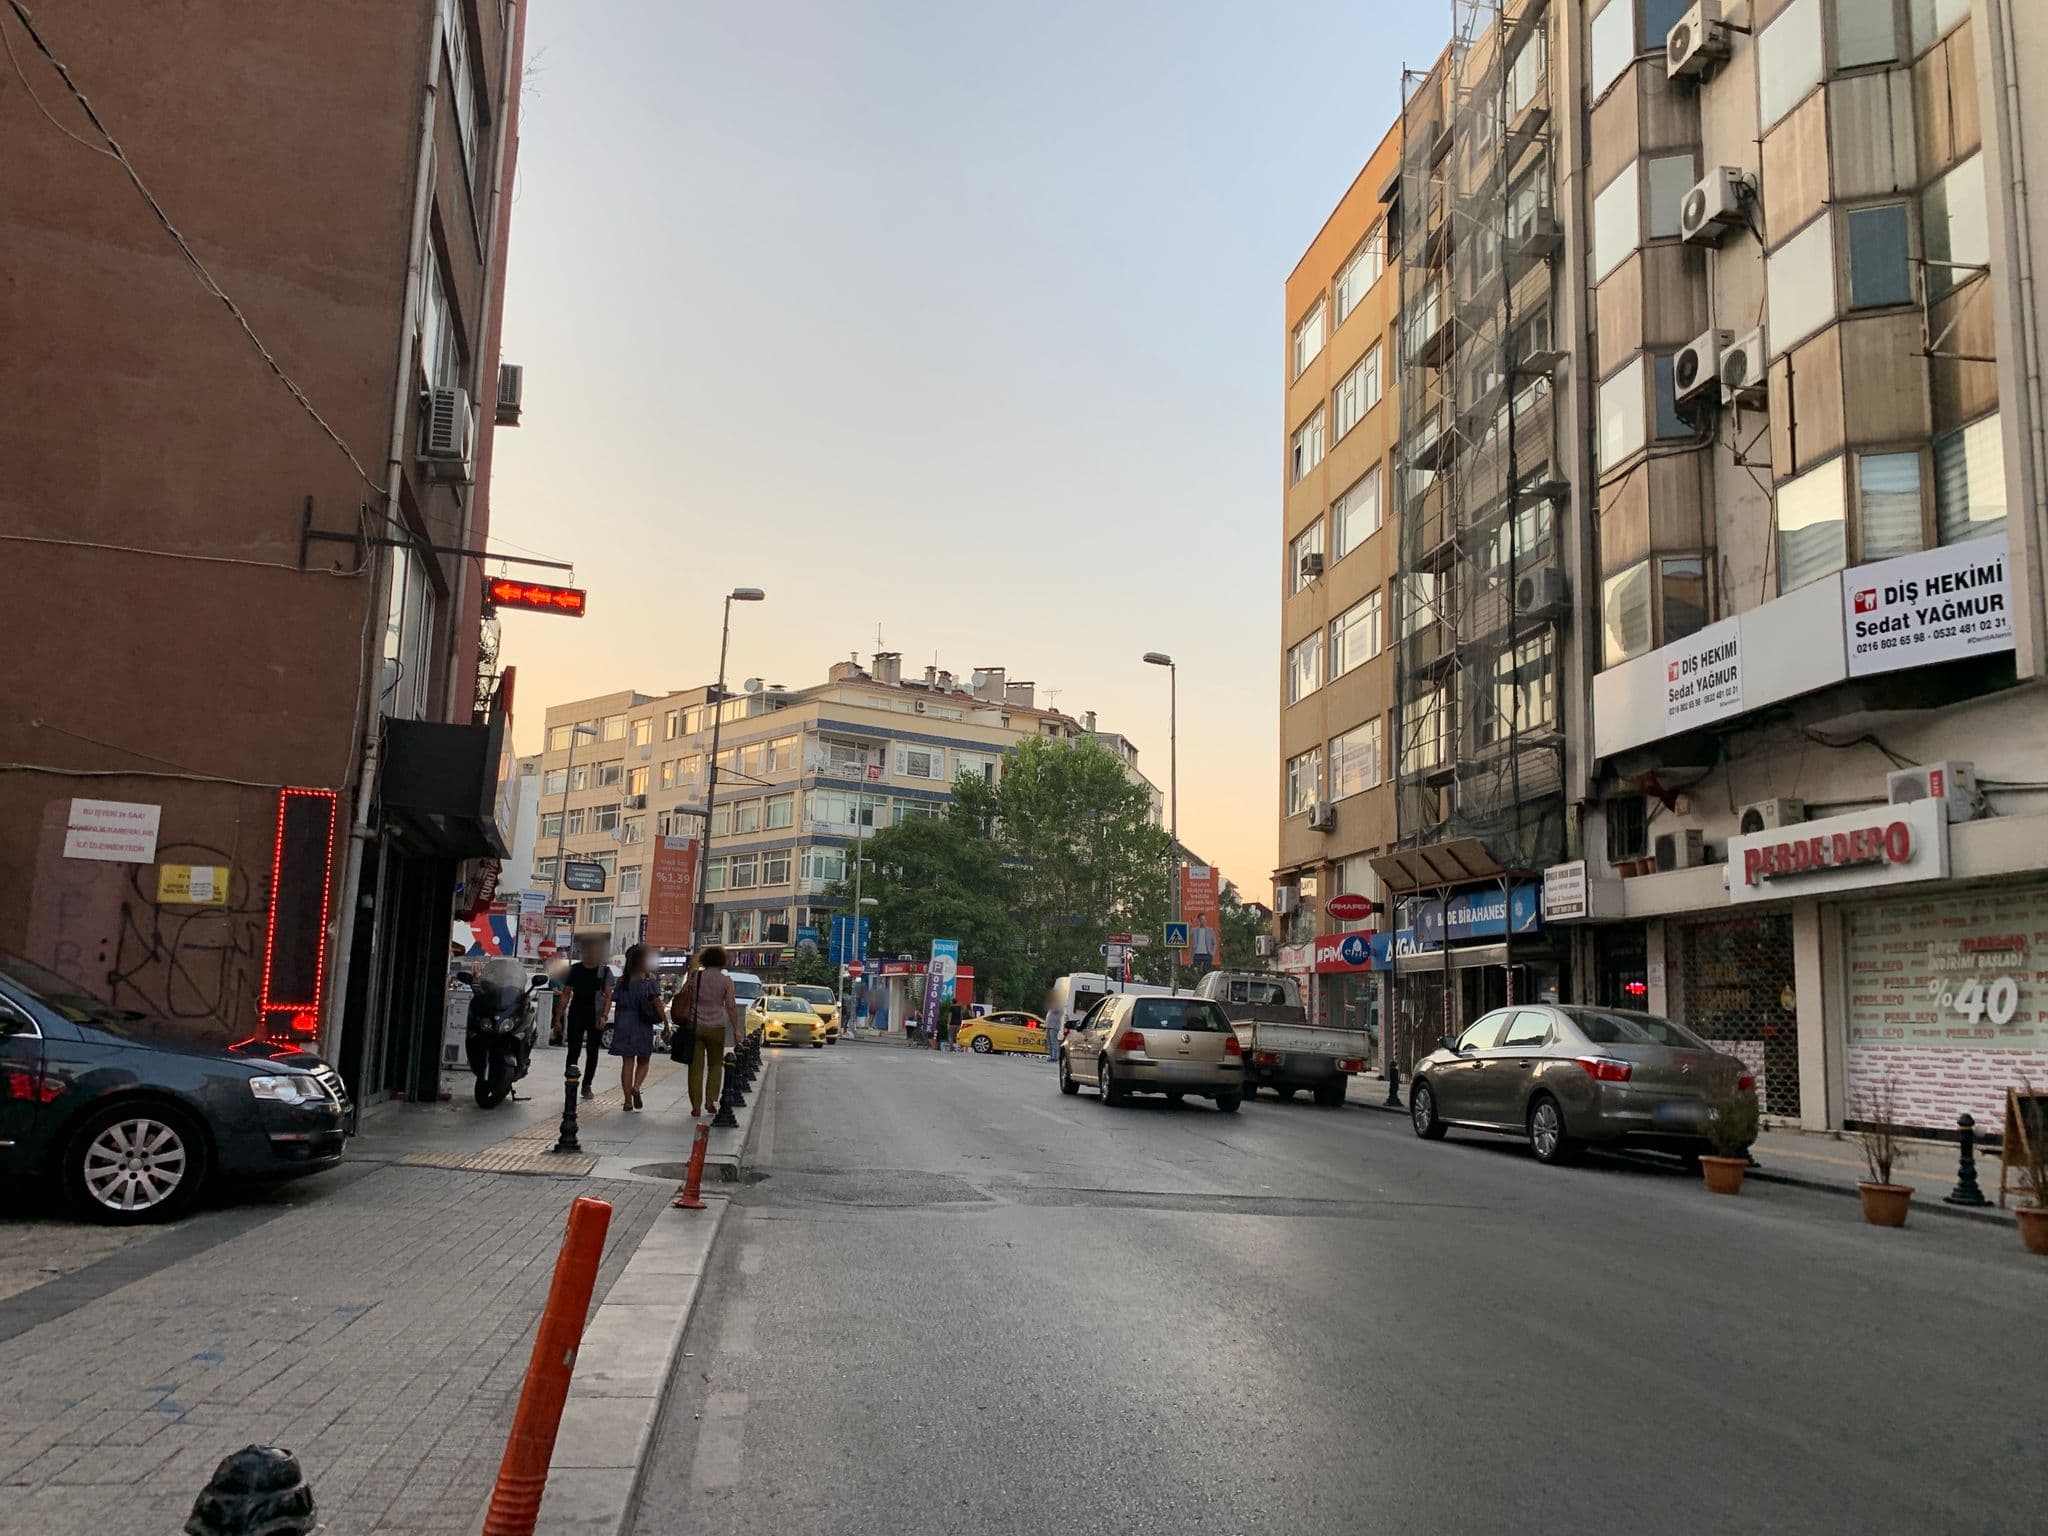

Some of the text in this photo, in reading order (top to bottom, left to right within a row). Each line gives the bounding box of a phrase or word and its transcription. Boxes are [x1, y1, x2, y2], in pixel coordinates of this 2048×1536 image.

[1884, 558, 2004, 606] DİŞ HEKİMİ
[1856, 594, 2004, 638] Sedat YAĞMUR
[1856, 638, 1879, 654] 0216
[1880, 636, 1898, 650] 802
[1900, 633, 1912, 646] 65
[1914, 632, 1926, 644] 98
[1933, 626, 1957, 642] 0532
[1960, 622, 1976, 634] 481
[1980, 620, 1992, 630] 02
[1995, 618, 2006, 628] 31
[1682, 636, 1737, 676] DİŞ HEKİMİ
[1668, 666, 1738, 702] Sedat YAĞMUR
[1744, 822, 1912, 886] PERDE DEPO
[1928, 977, 2018, 1025] %40
